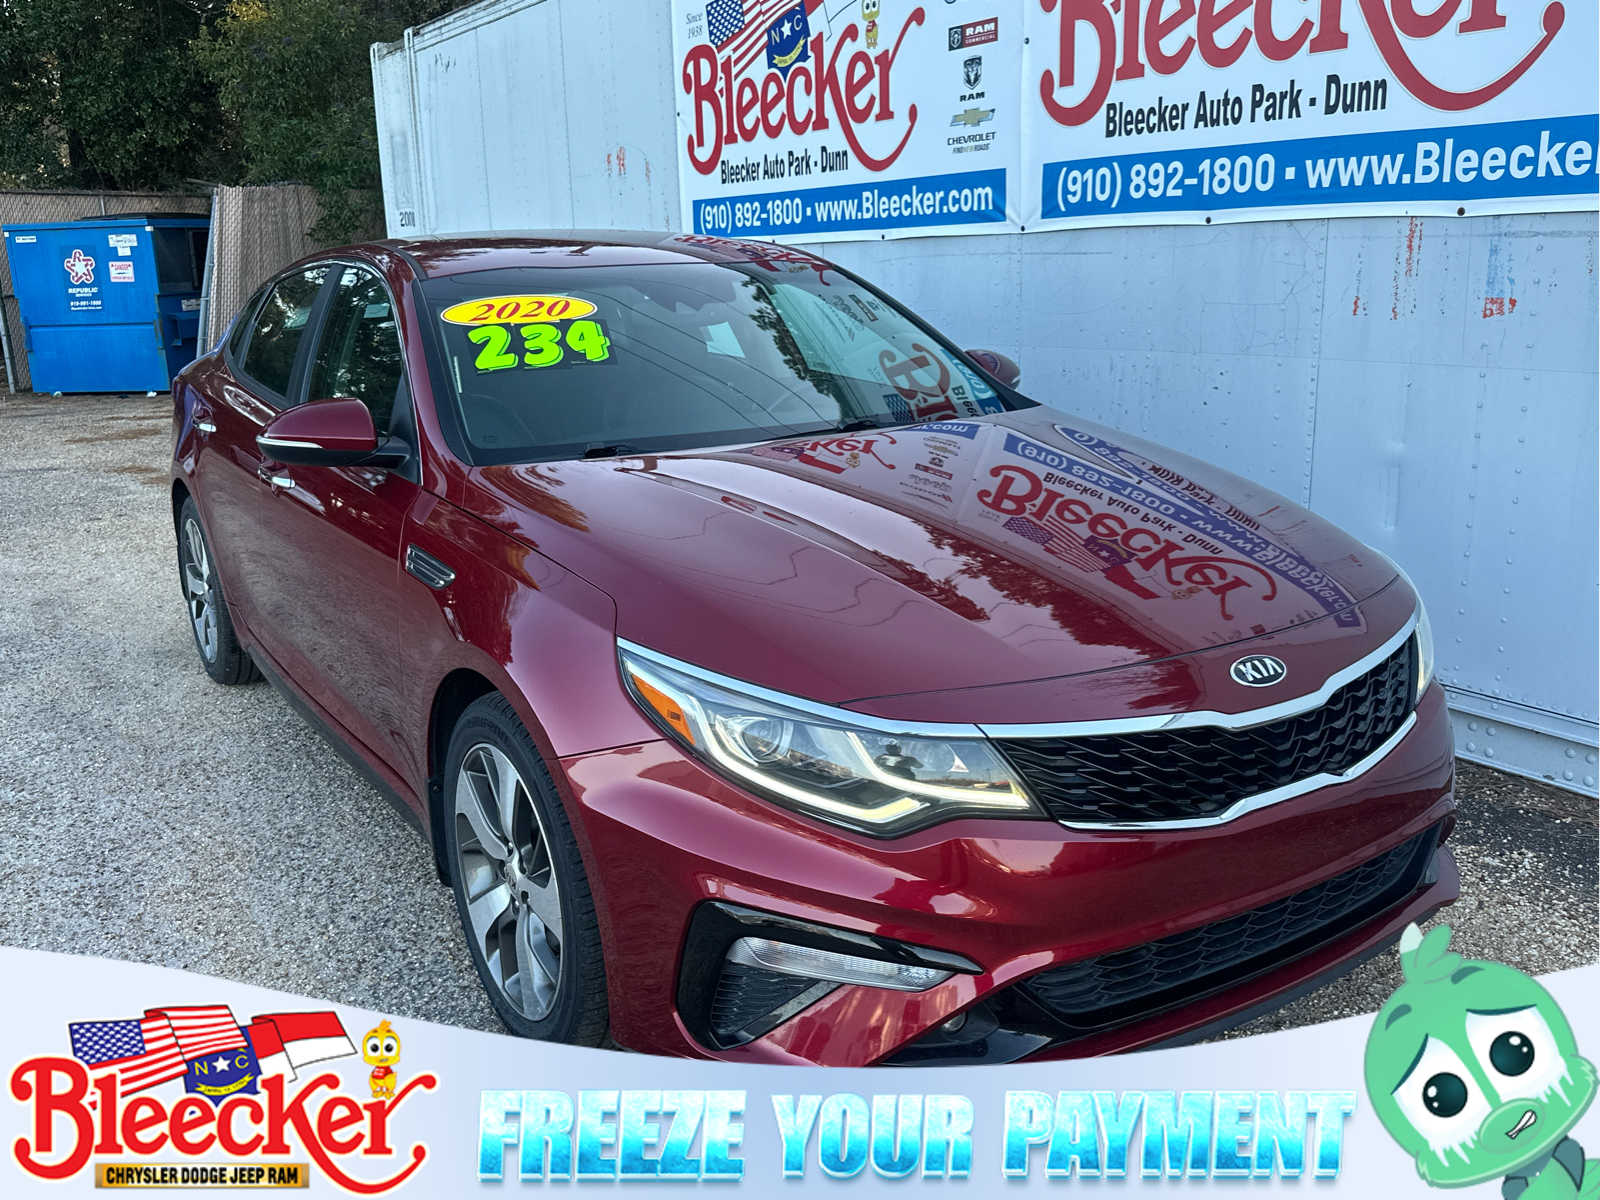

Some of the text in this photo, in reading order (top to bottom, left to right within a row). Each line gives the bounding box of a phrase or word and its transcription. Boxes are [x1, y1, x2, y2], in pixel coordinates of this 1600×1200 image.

[686, 12, 703, 24] Since
[771, 15, 803, 46] N C
[966, 22, 995, 36] RAM
[682, 7, 926, 176] Bleecker
[960, 91, 985, 102] RAM
[1105, 74, 1387, 138] Bleecker Auto Park Dunn
[947, 131, 996, 146] CHEVROLET
[721, 145, 848, 184] Bleecker Auto Park Dunn
[1057, 161, 1122, 211] (910)
[1129, 153, 1275, 199] 892-1800
[700, 185, 993, 234] (910) 892-1800 www.Bleecker.com
[469, 300, 570, 322] 2020
[467, 320, 611, 371] 234
[1237, 658, 1283, 682] KIA
